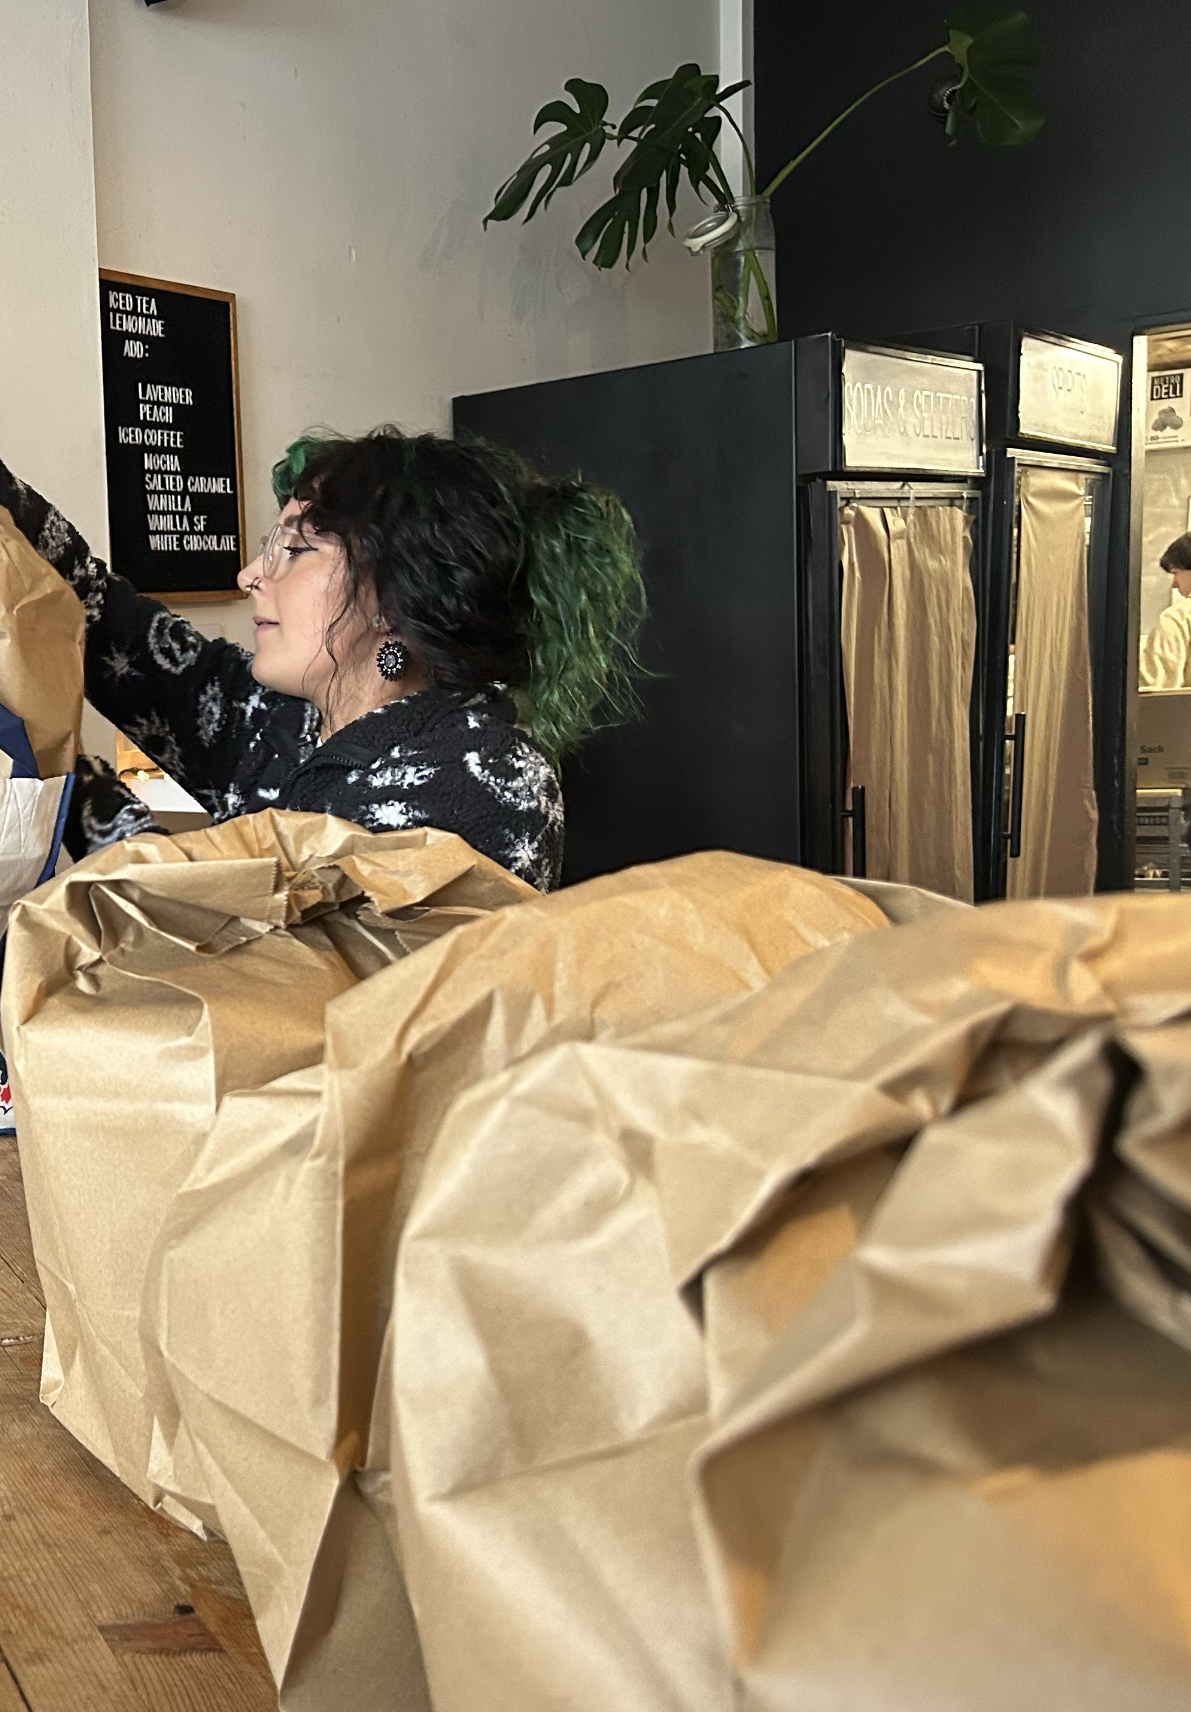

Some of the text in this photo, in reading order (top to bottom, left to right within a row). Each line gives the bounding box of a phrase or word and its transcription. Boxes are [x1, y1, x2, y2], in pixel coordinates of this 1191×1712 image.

[108, 289, 158, 316] ICED TEA
[109, 311, 165, 338] LEMONADE
[138, 382, 194, 406] LAVENDER
[1153, 383, 1181, 399] DELI
[139, 403, 173, 424] PEACH
[844, 381, 893, 436] SODAS
[118, 426, 184, 448] ICED COFFEE
[144, 452, 181, 472] MOCHA
[145, 473, 234, 494] SALTED CARAMEL
[146, 493, 191, 512] VANILLA
[147, 514, 207, 532] VANILLA SF
[148, 534, 237, 551] WHITE CHOCOLATE
